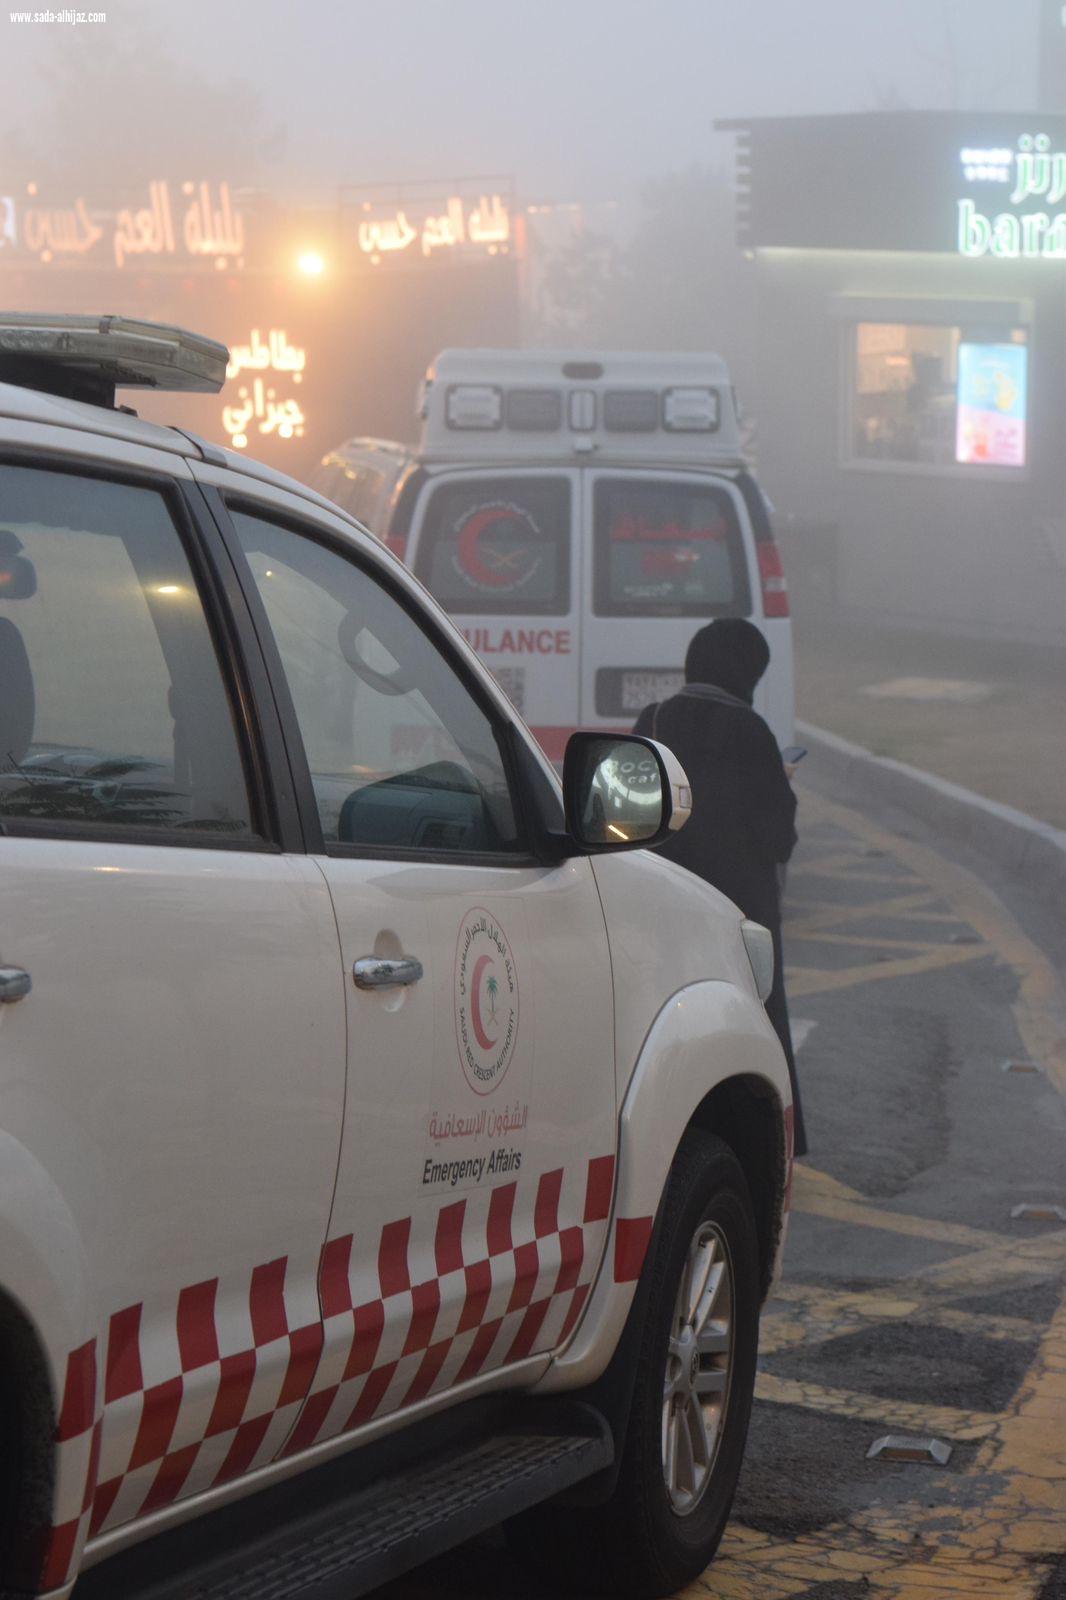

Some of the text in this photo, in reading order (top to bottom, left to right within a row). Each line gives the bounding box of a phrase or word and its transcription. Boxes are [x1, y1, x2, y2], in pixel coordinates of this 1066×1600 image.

[113, 179, 176, 269] العم
[463, 627, 572, 655] ULANCE
[422, 1147, 522, 1187] Emergency Affairs
